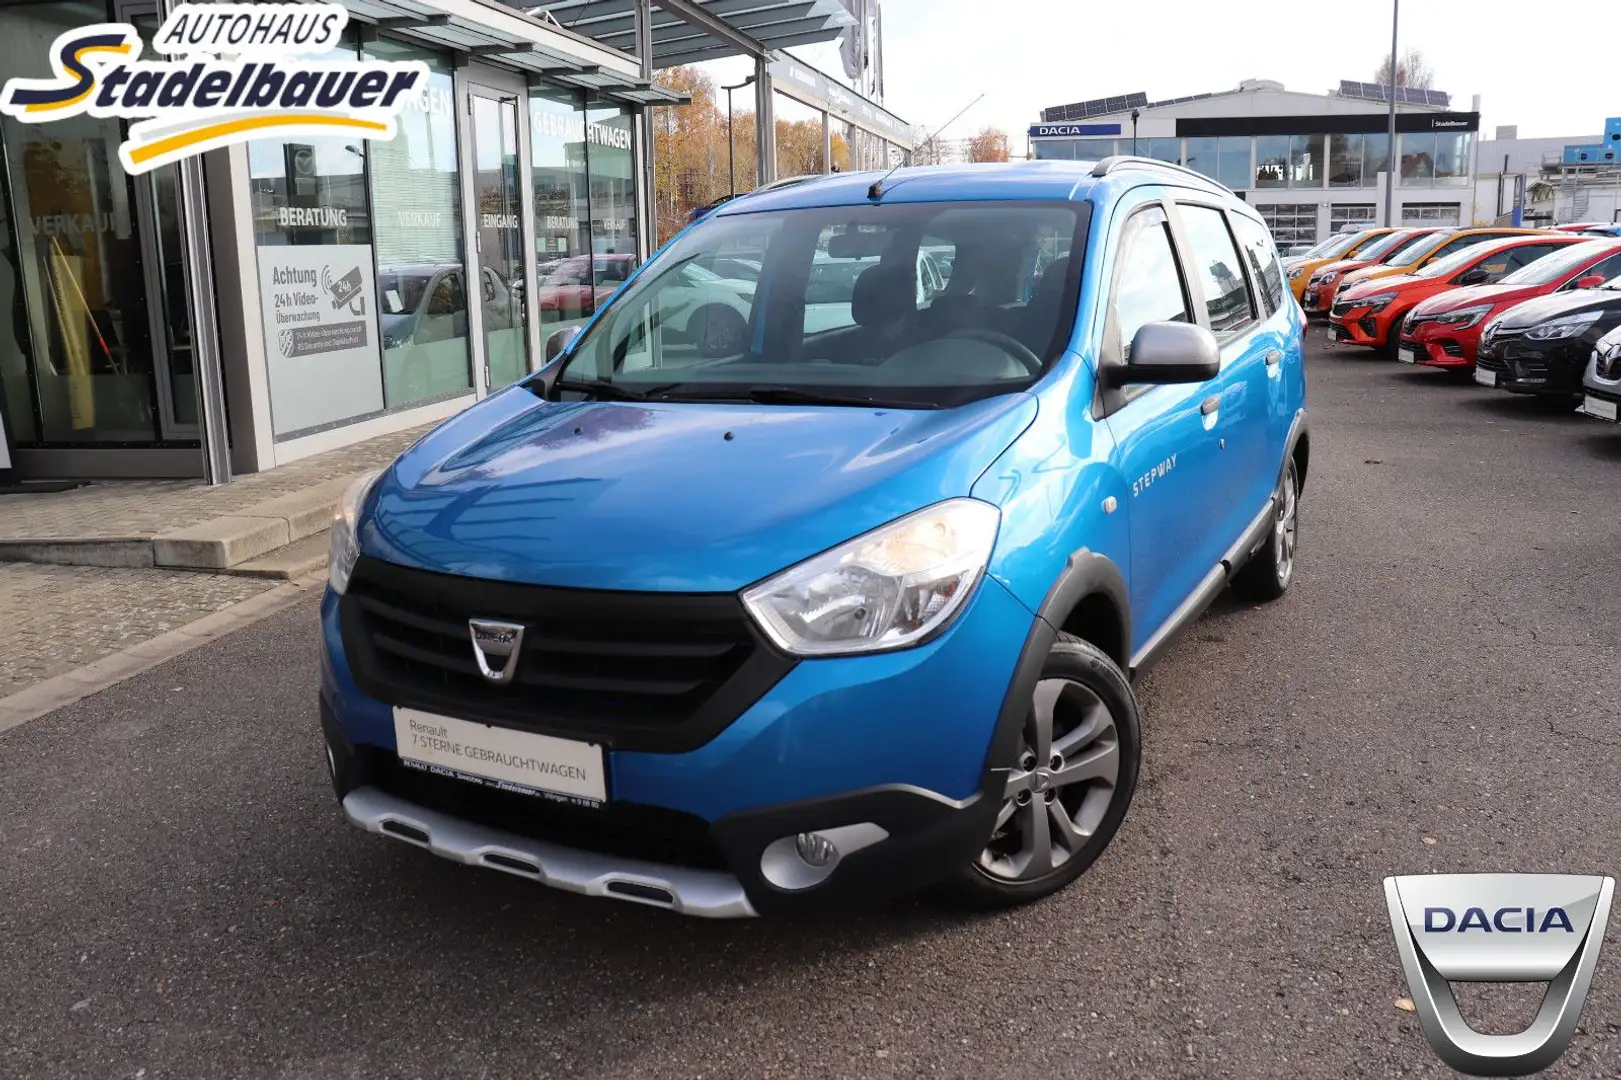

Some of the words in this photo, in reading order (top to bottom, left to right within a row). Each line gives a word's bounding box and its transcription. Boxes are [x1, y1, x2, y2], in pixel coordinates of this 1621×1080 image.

[1039, 126, 1081, 135] DACIA
[279, 207, 348, 226] BERATUNG
[483, 213, 518, 229] EINGANG
[547, 215, 579, 229] BERATUNG
[273, 265, 318, 288] Achtung
[337, 280, 351, 293] 24h
[293, 291, 319, 307] Video-
[276, 310, 321, 324] Überwachung
[1132, 452, 1177, 498] STEPWAY
[409, 719, 448, 738] Renault
[411, 735, 418, 746] 7
[420, 736, 463, 757] STERNE
[465, 746, 587, 781] GEBRAUCHTWAGEN
[430, 766, 455, 777] DACIA
